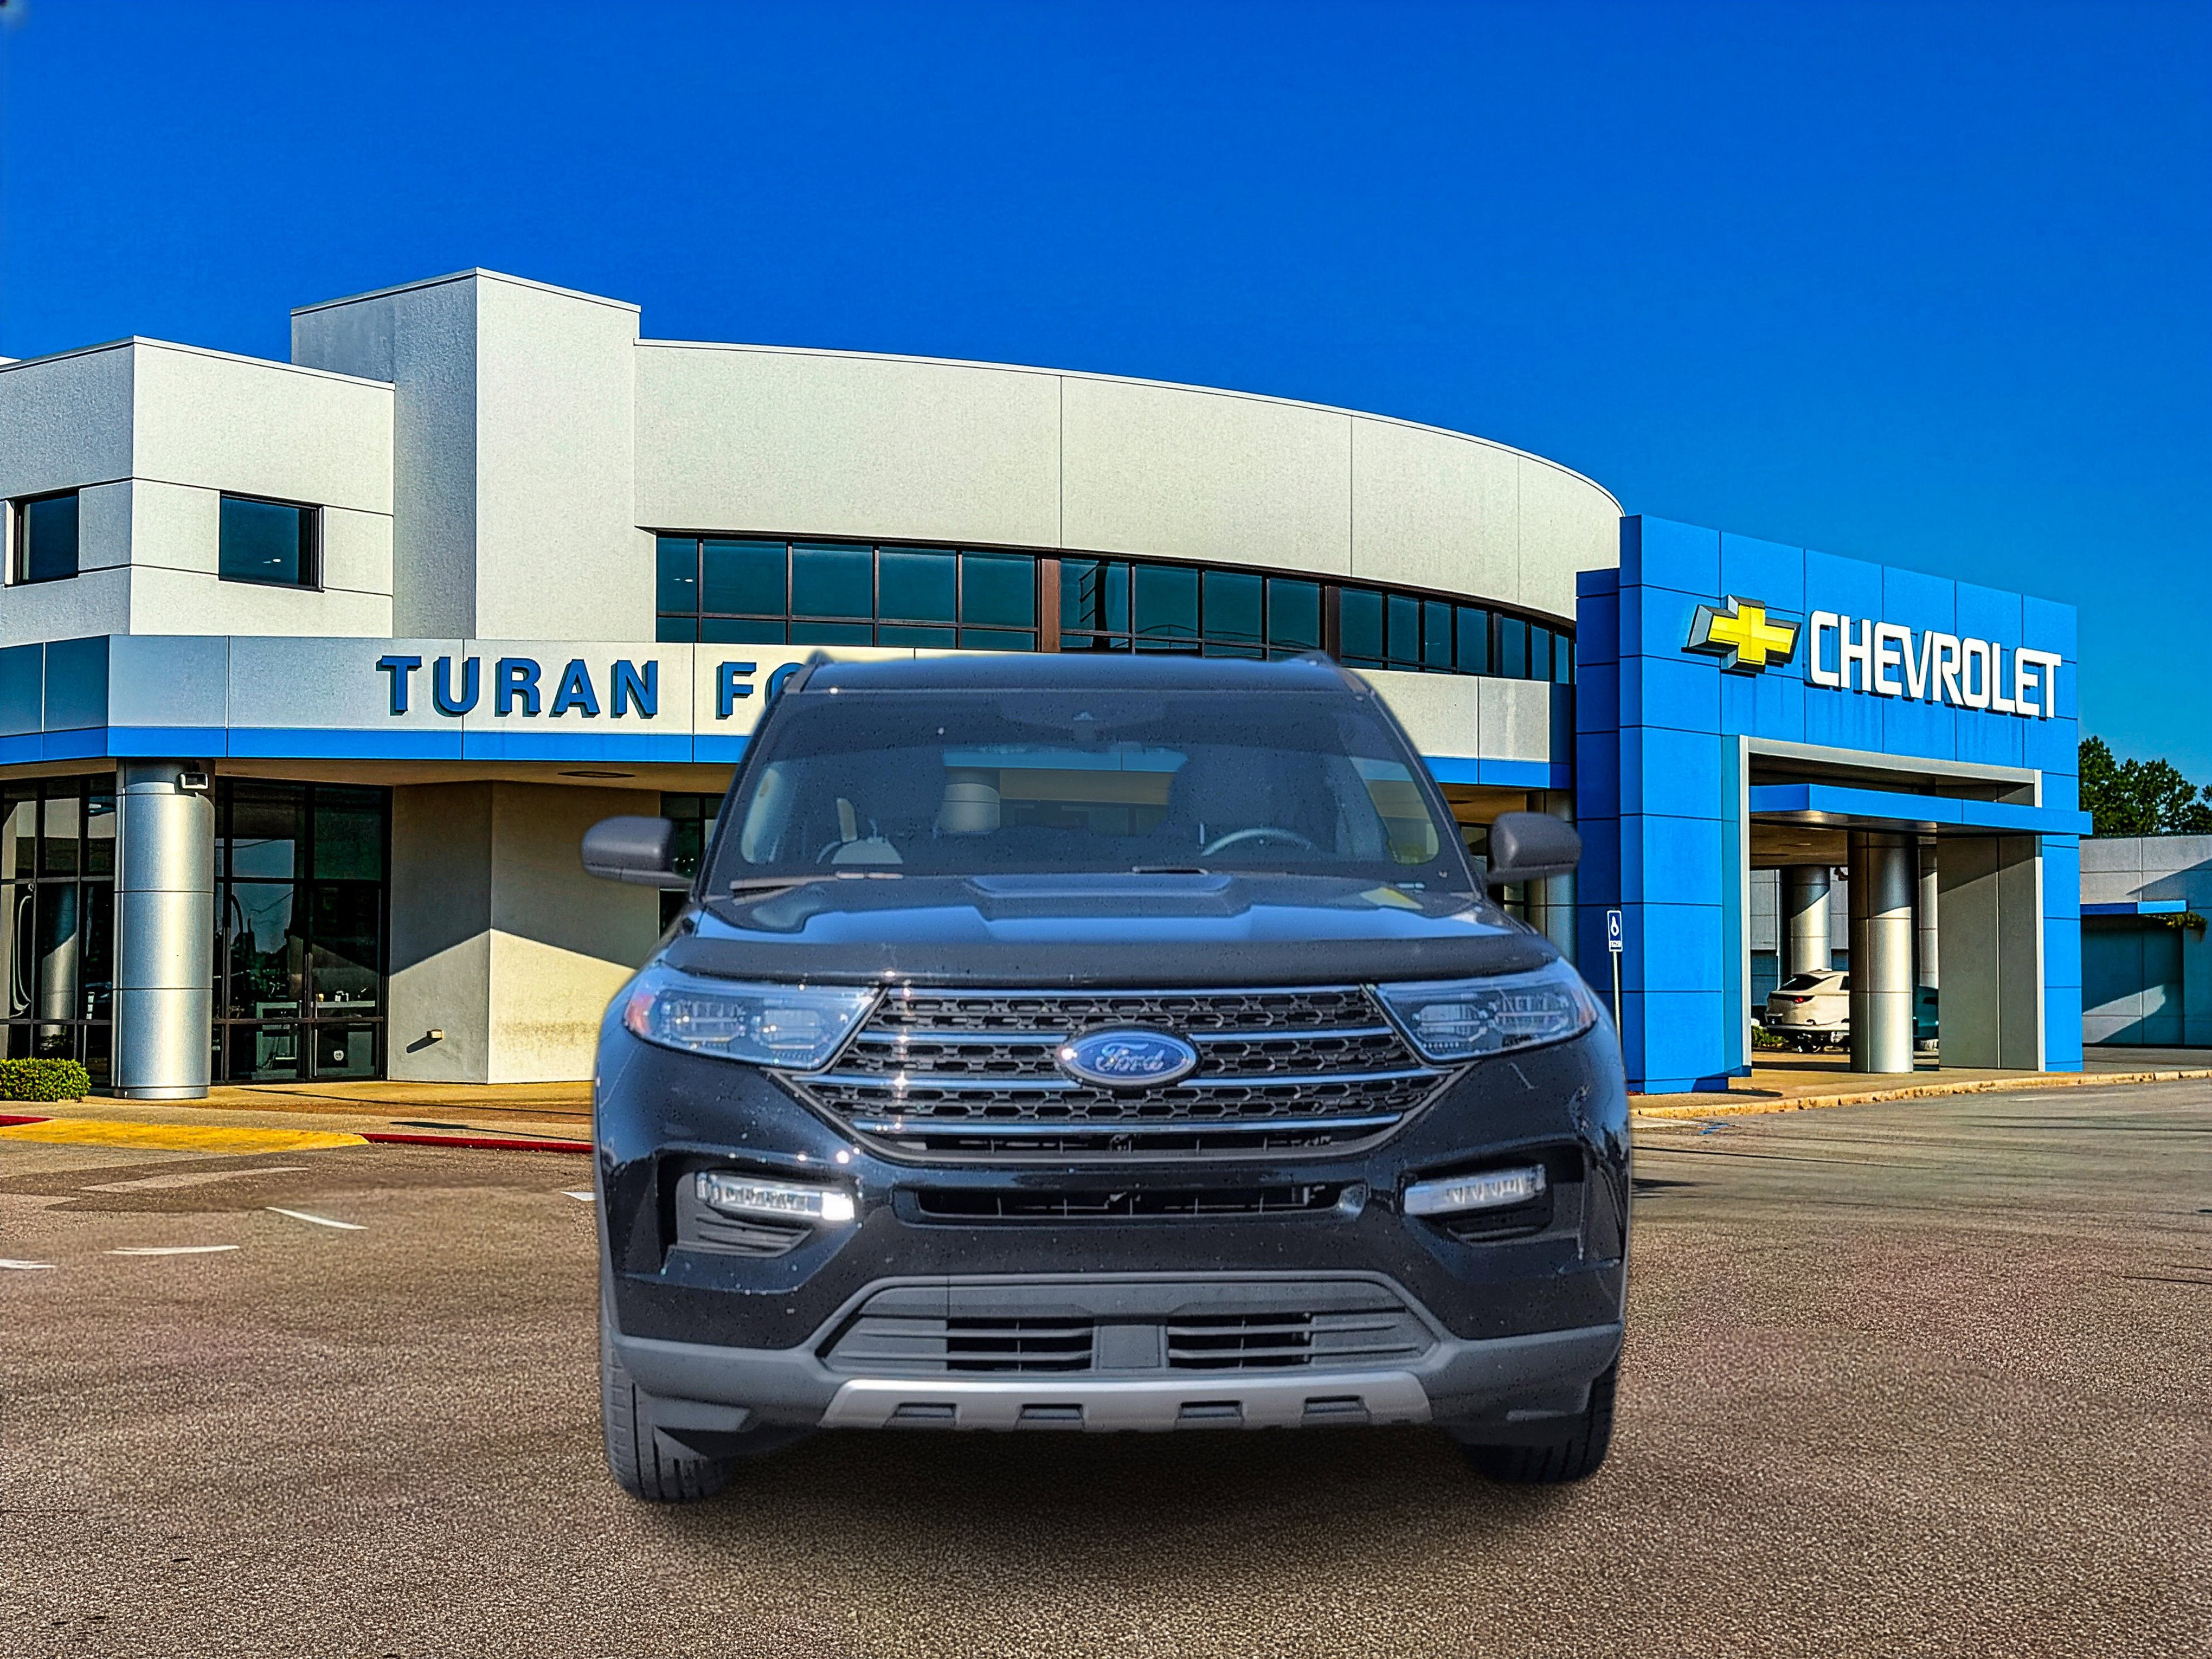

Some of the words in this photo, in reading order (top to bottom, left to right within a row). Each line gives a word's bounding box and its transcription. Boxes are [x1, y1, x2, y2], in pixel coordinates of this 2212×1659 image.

[376, 655, 658, 719] TURAN
[1809, 609, 2062, 718] CHEVROLET
[1095, 1042, 1166, 1072] Ford
